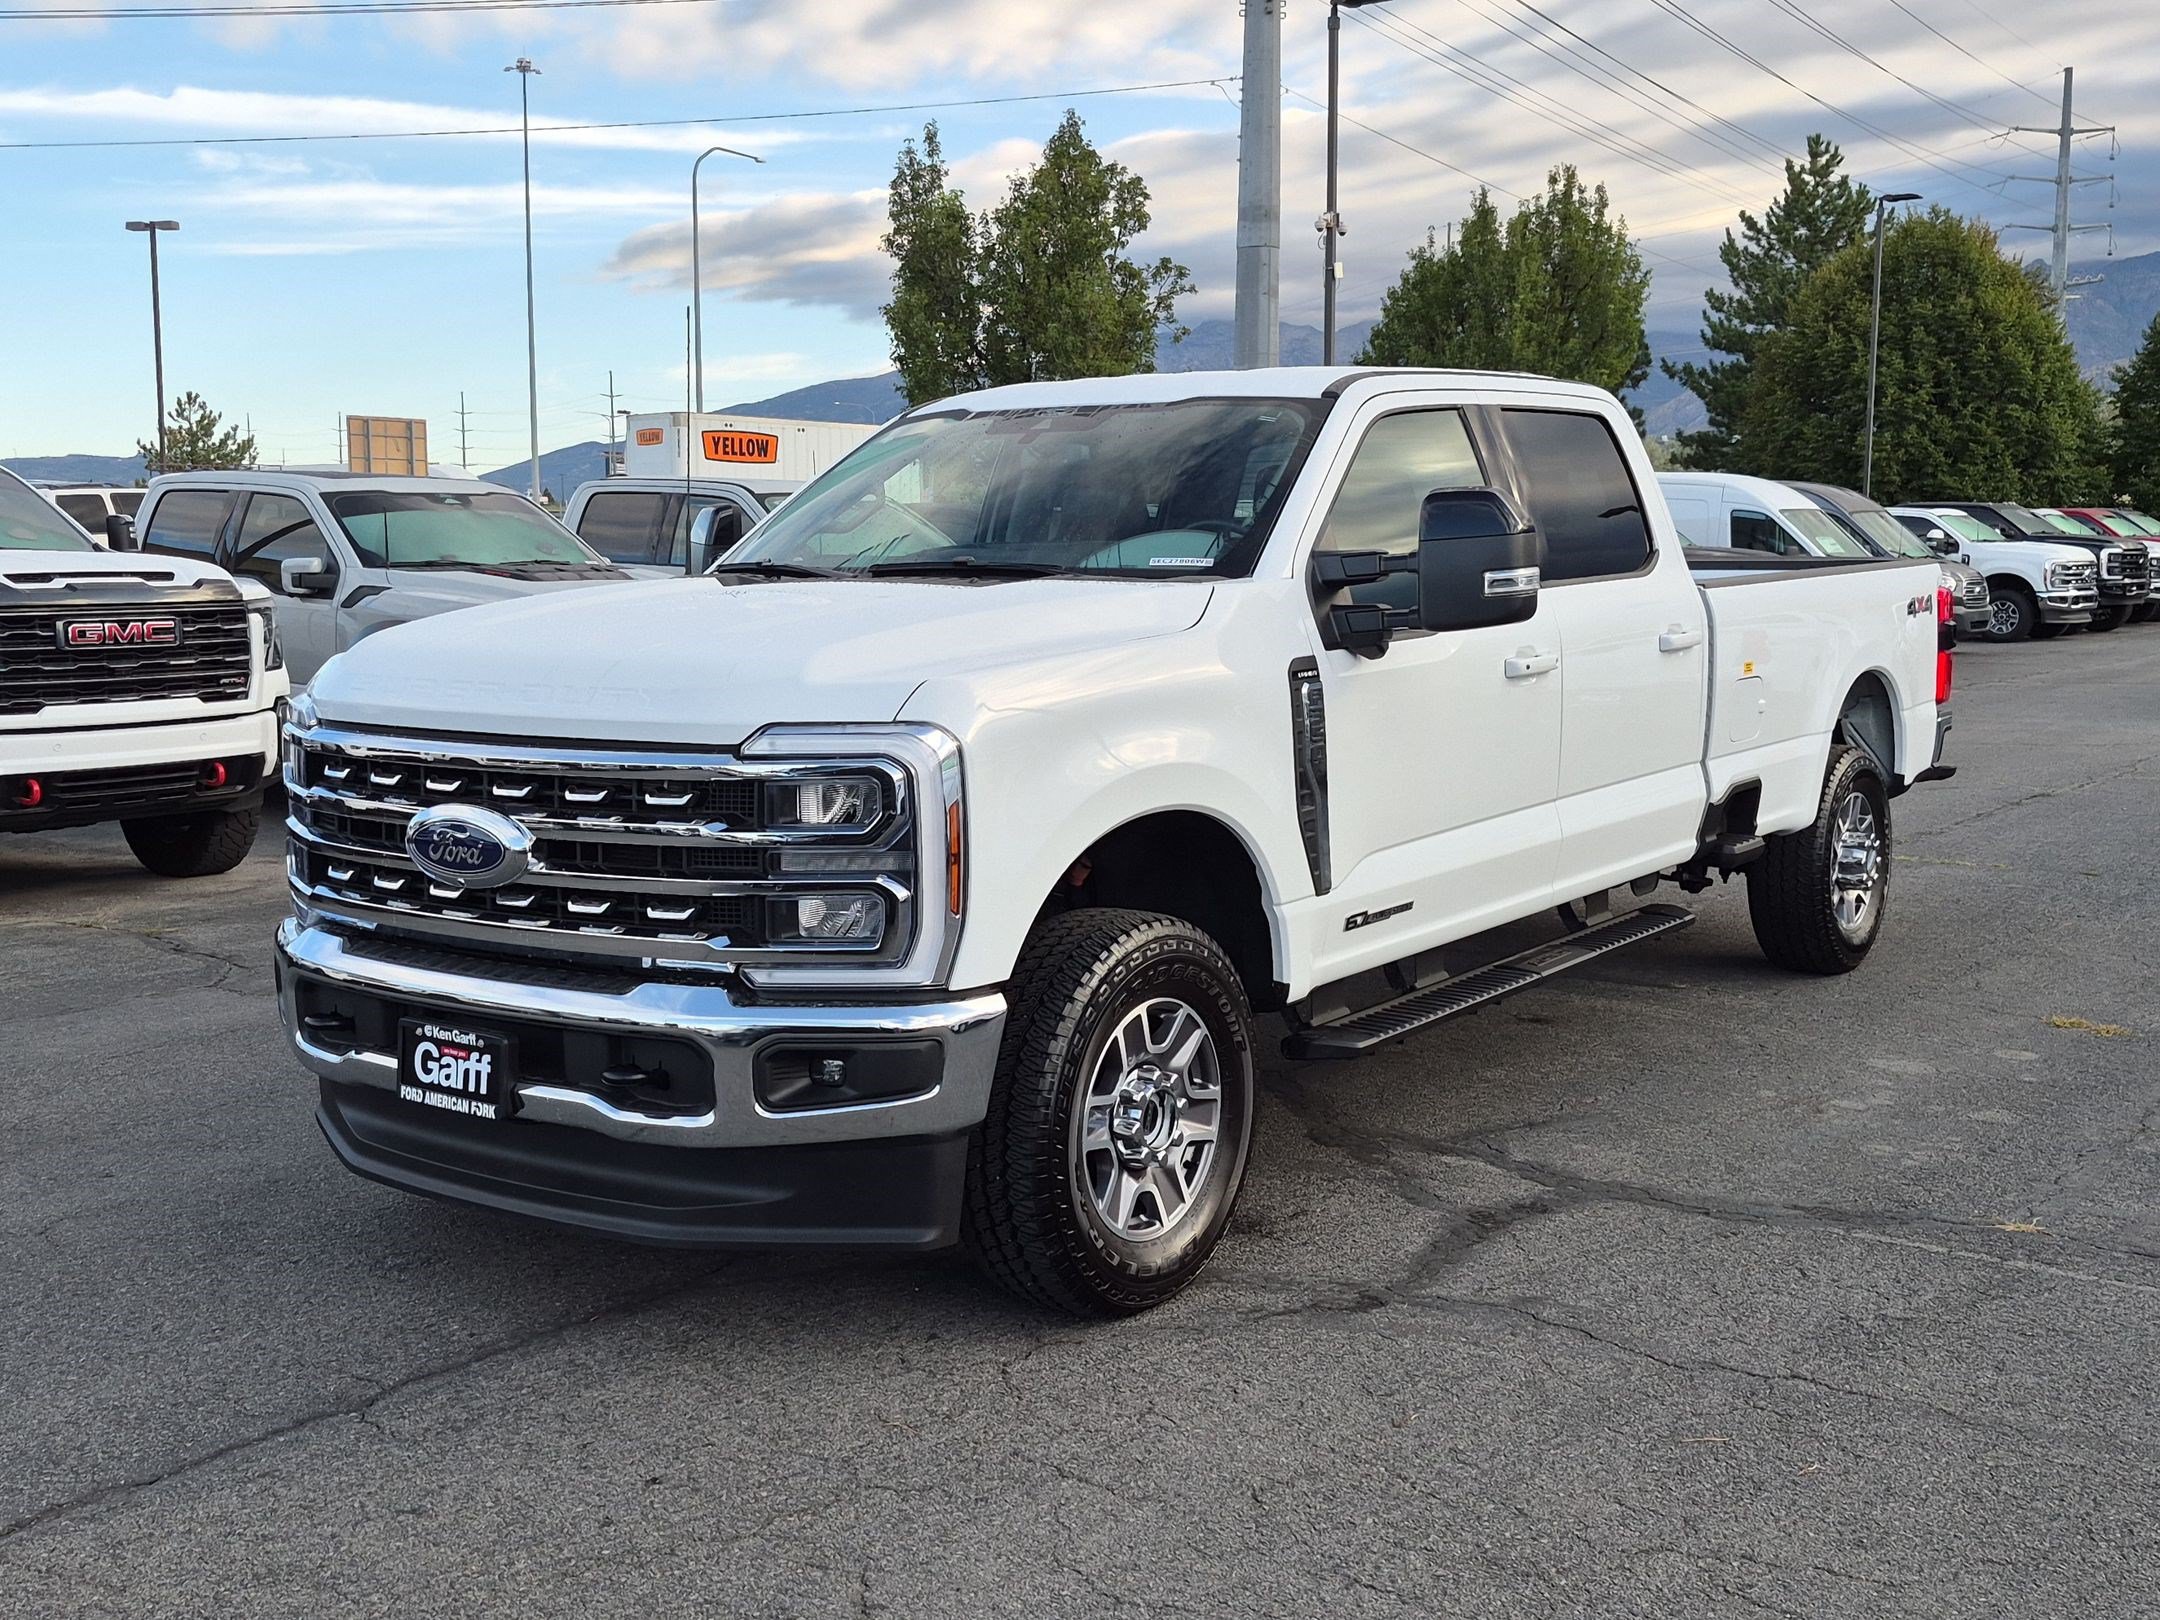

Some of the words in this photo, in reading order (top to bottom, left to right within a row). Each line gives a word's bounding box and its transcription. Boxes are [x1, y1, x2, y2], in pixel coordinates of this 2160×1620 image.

[639, 431, 660, 442] YELLOW
[712, 436, 769, 458] YELLOW
[68, 620, 175, 645] GMC
[428, 827, 484, 865] Ford
[432, 1025, 452, 1041] Ken
[452, 1029, 477, 1046] Garff
[414, 1041, 491, 1094] Garff
[400, 1084, 424, 1102] FORD
[424, 1091, 470, 1114] AMERICAN
[471, 1101, 497, 1120] FORK
